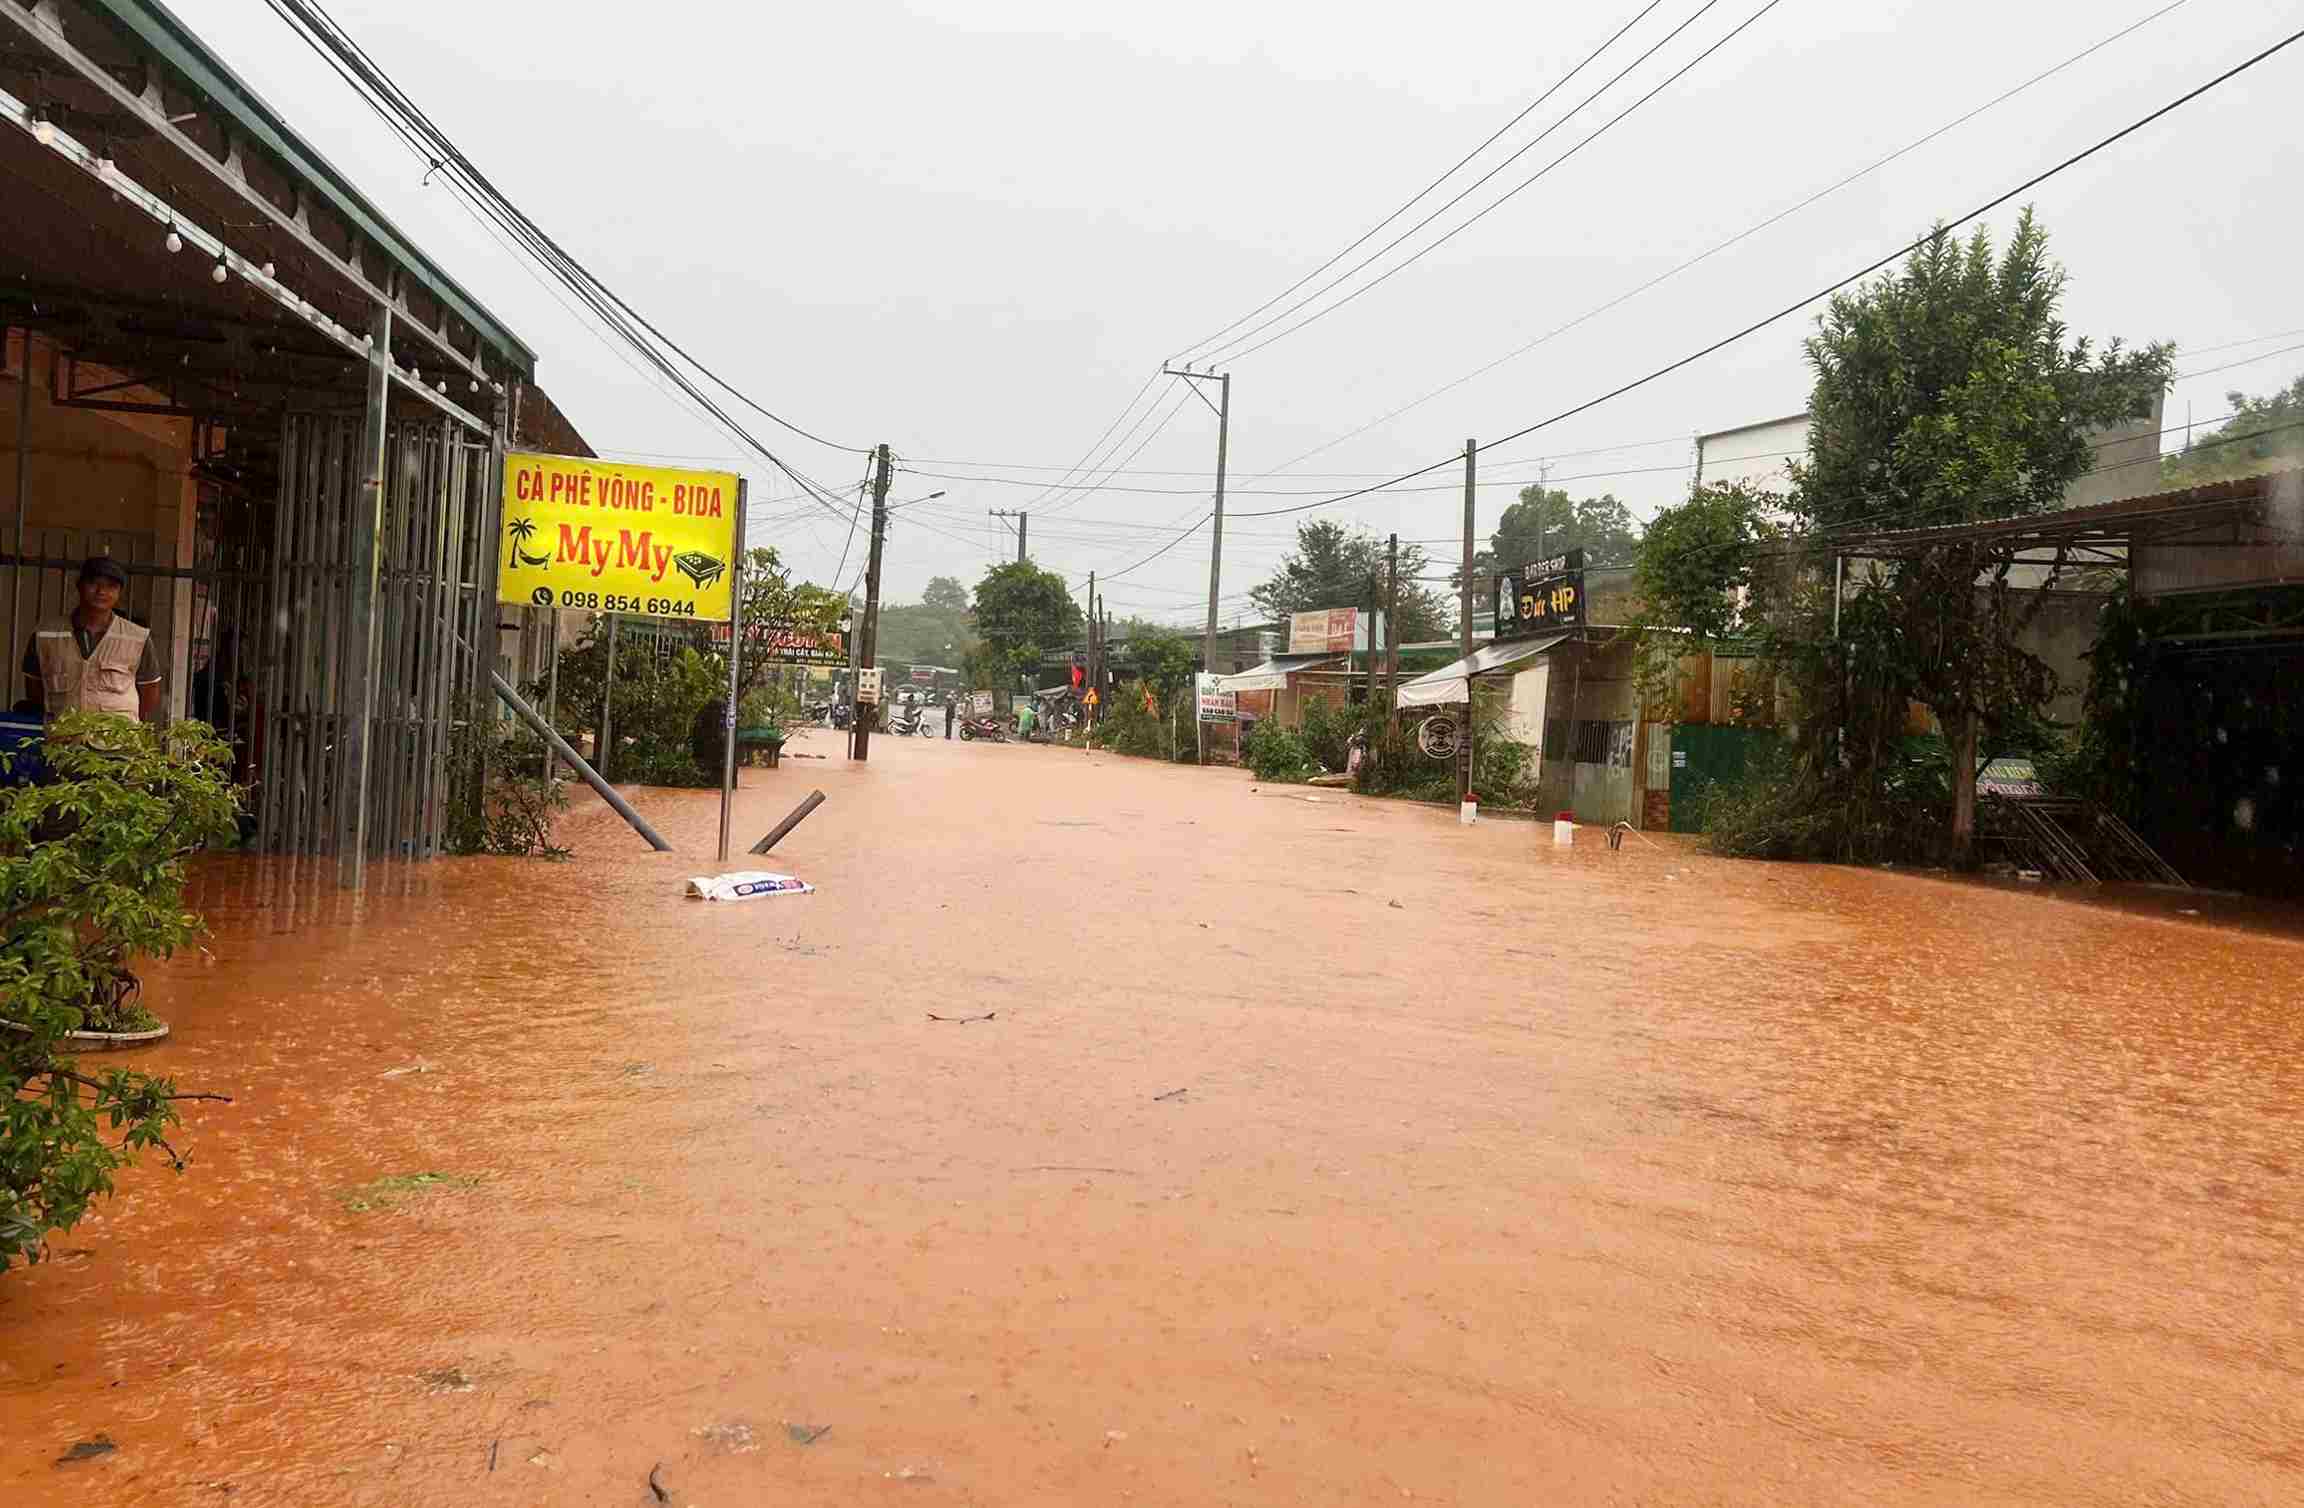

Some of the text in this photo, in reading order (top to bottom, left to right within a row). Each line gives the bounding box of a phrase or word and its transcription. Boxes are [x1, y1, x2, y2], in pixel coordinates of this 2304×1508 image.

[517, 464, 544, 502] CÀ
[550, 469, 592, 506] PHÊ
[597, 473, 654, 512] VÕNG
[673, 484, 722, 518] BIDA
[562, 590, 696, 617] 098 854 6944
[1551, 586, 1575, 613] HP
